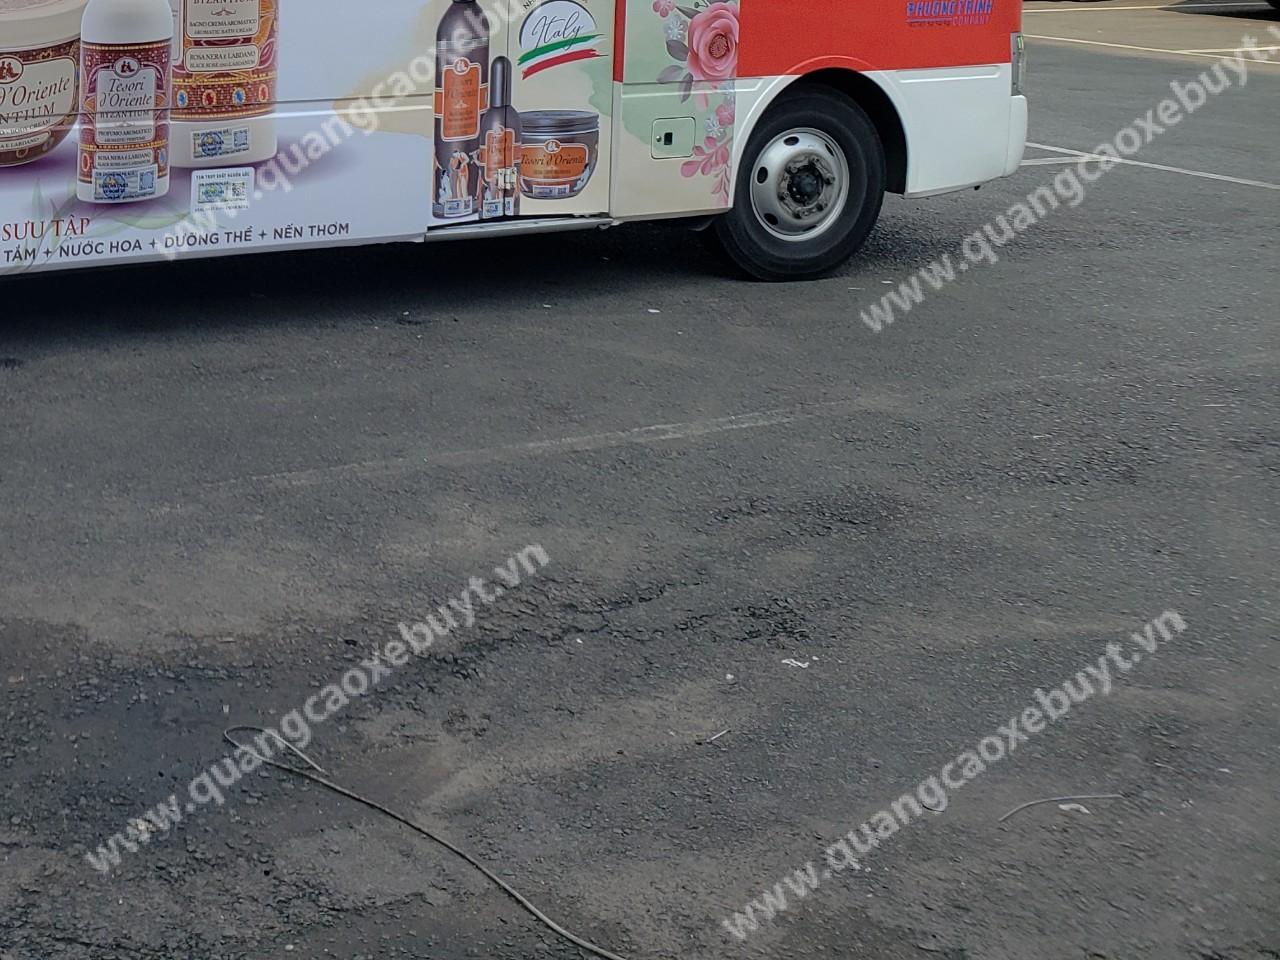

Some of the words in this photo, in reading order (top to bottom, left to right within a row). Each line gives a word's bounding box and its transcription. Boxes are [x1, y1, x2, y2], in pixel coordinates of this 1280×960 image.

[531, 8, 584, 50] Italy
[109, 77, 147, 92] Tesori
[99, 92, 153, 108] d'Oriente
[2, 219, 45, 242] SƯU
[51, 215, 90, 239] TẬP
[59, 240, 105, 258] NƯỚC
[109, 239, 142, 253] HOA
[308, 221, 350, 238] THƠM
